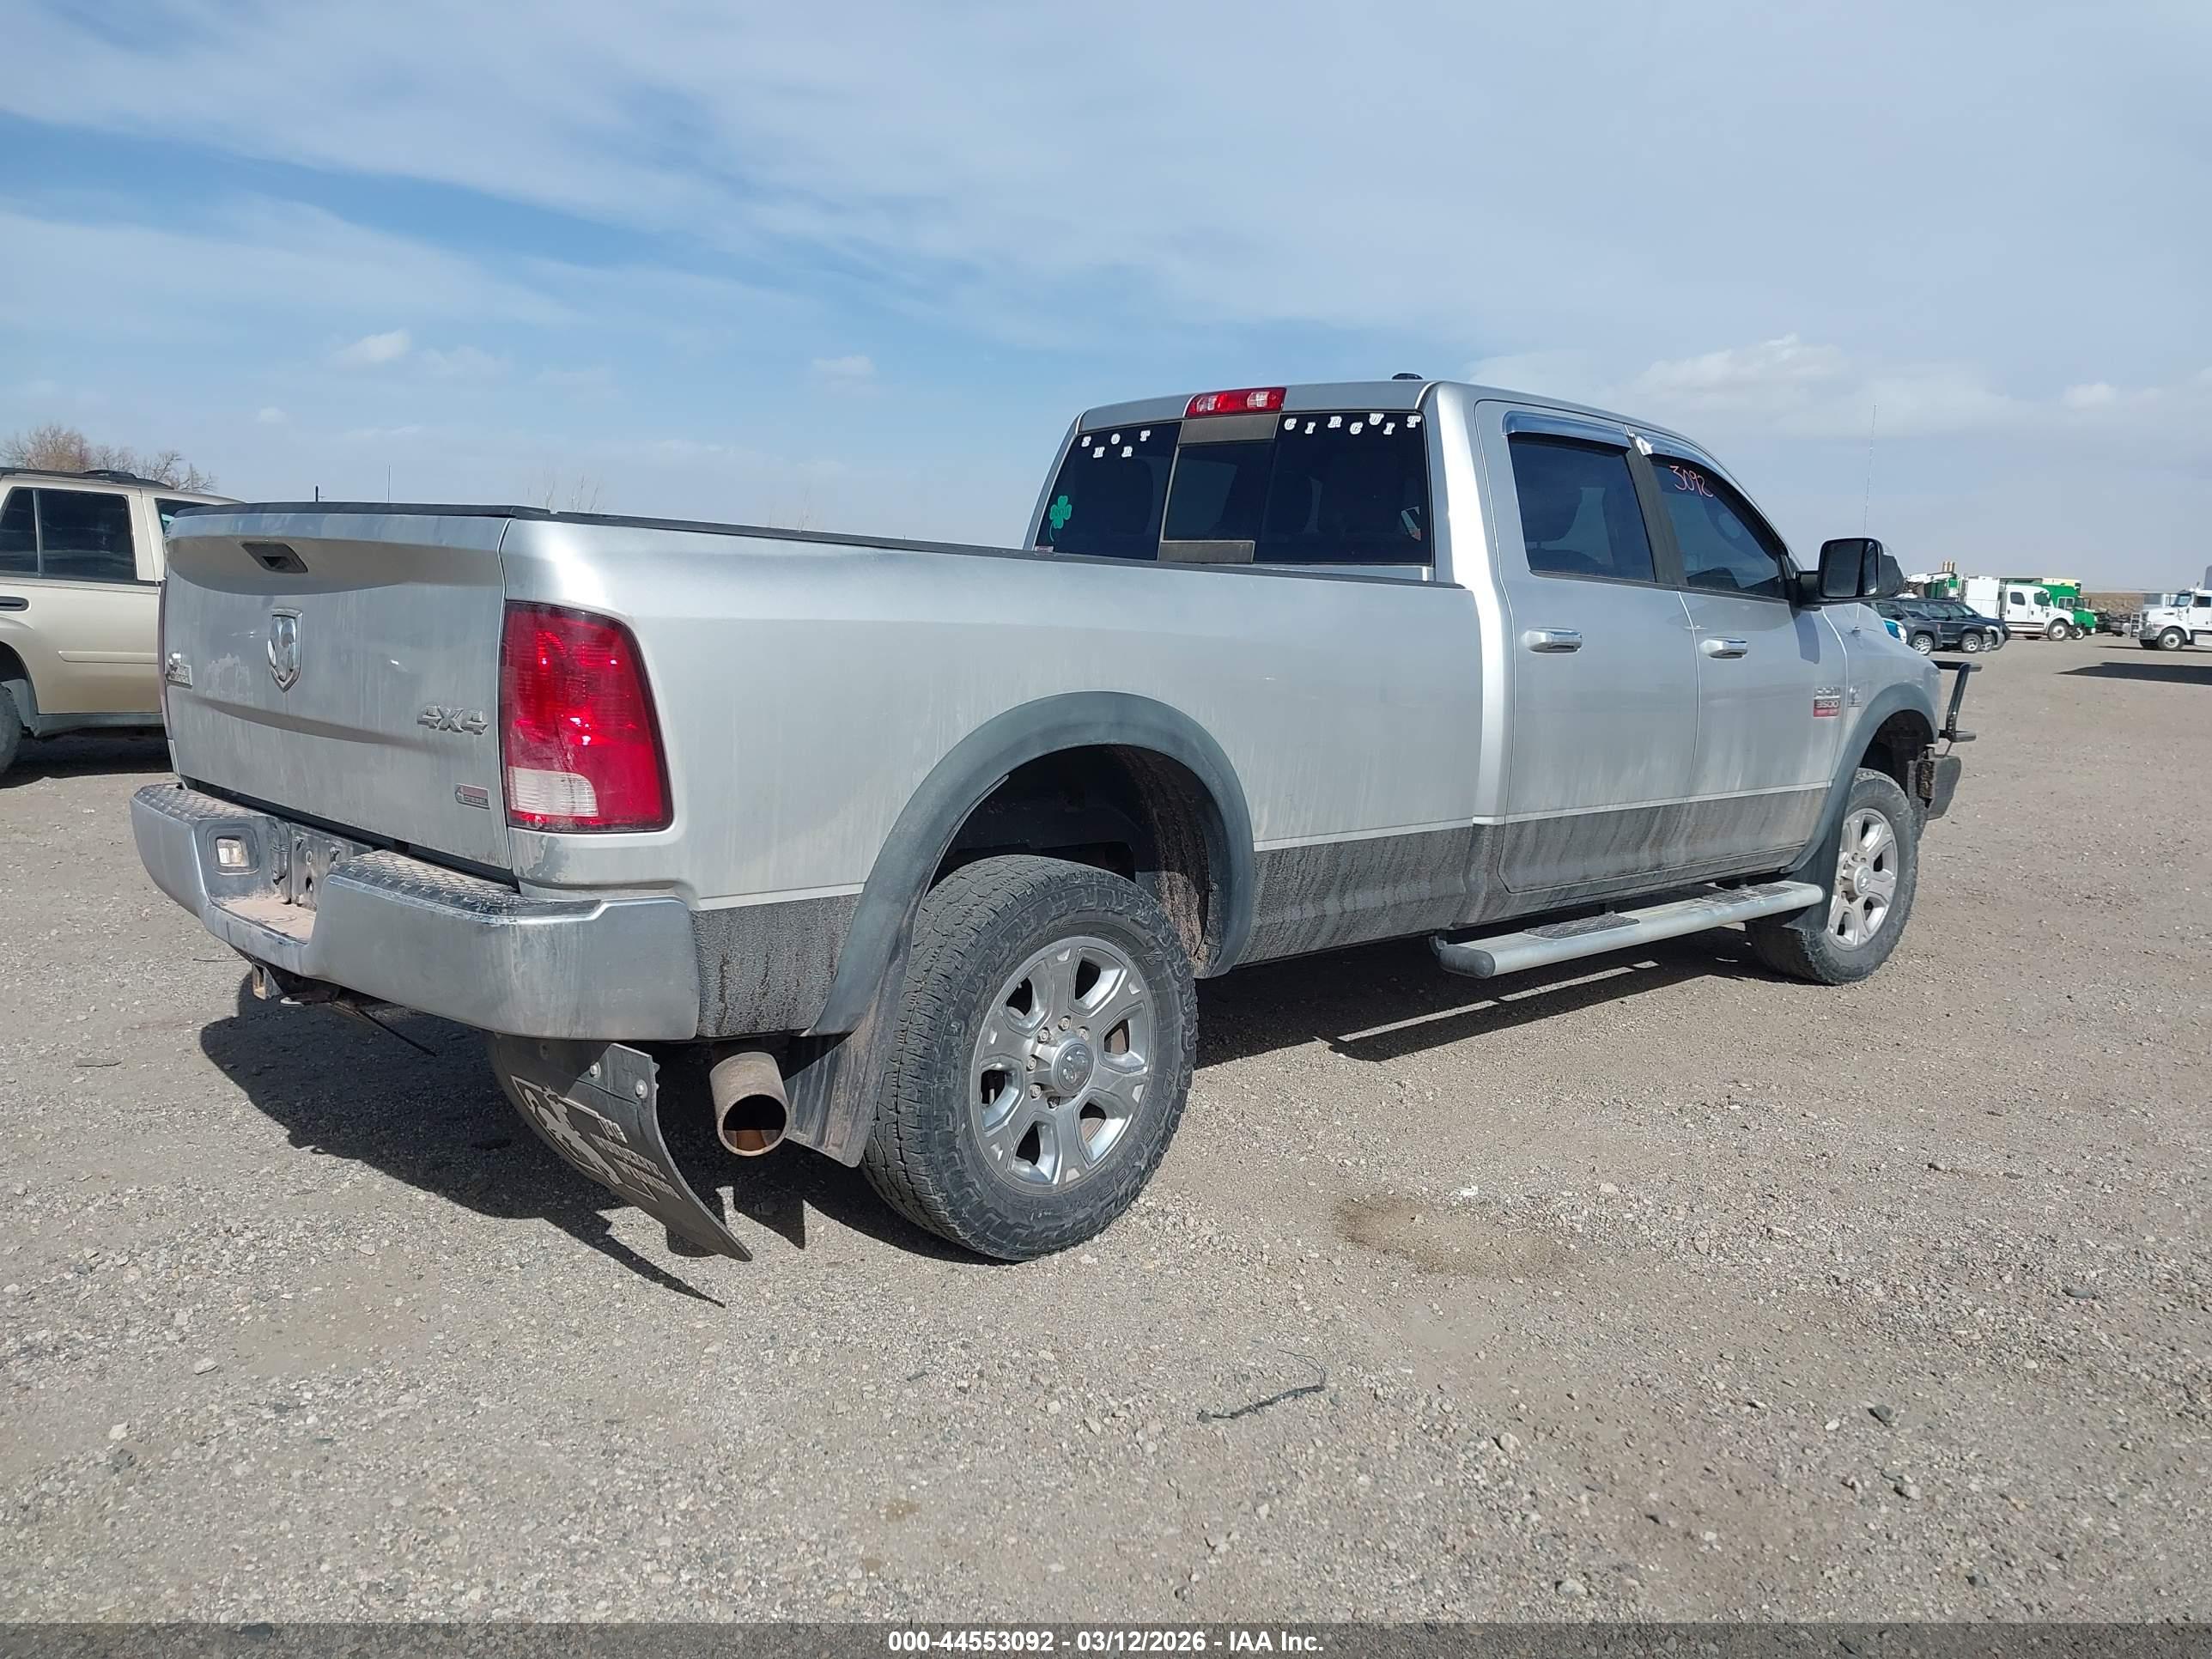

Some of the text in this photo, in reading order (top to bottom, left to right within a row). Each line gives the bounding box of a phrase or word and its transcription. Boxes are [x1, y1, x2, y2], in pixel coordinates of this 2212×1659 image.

[1081, 413, 1421, 459] SHORT CIRCUIT
[1669, 465, 1714, 497] 3092
